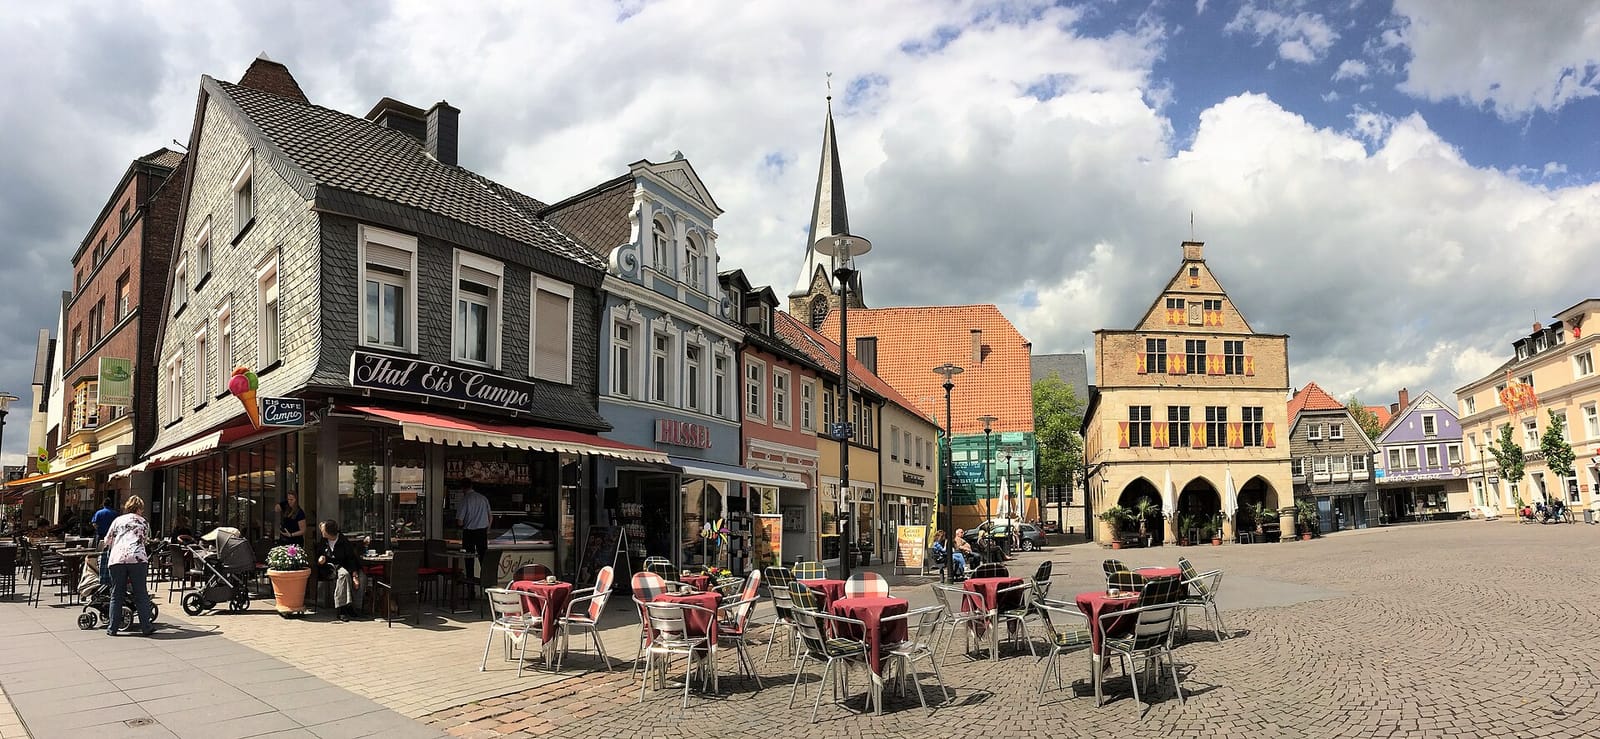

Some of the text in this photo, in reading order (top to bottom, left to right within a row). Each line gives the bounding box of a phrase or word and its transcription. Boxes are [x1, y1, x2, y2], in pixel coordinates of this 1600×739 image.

[357, 355, 530, 407] Ital Eis Campo
[264, 405, 303, 424] Campo
[659, 419, 712, 448] HUSSEL
